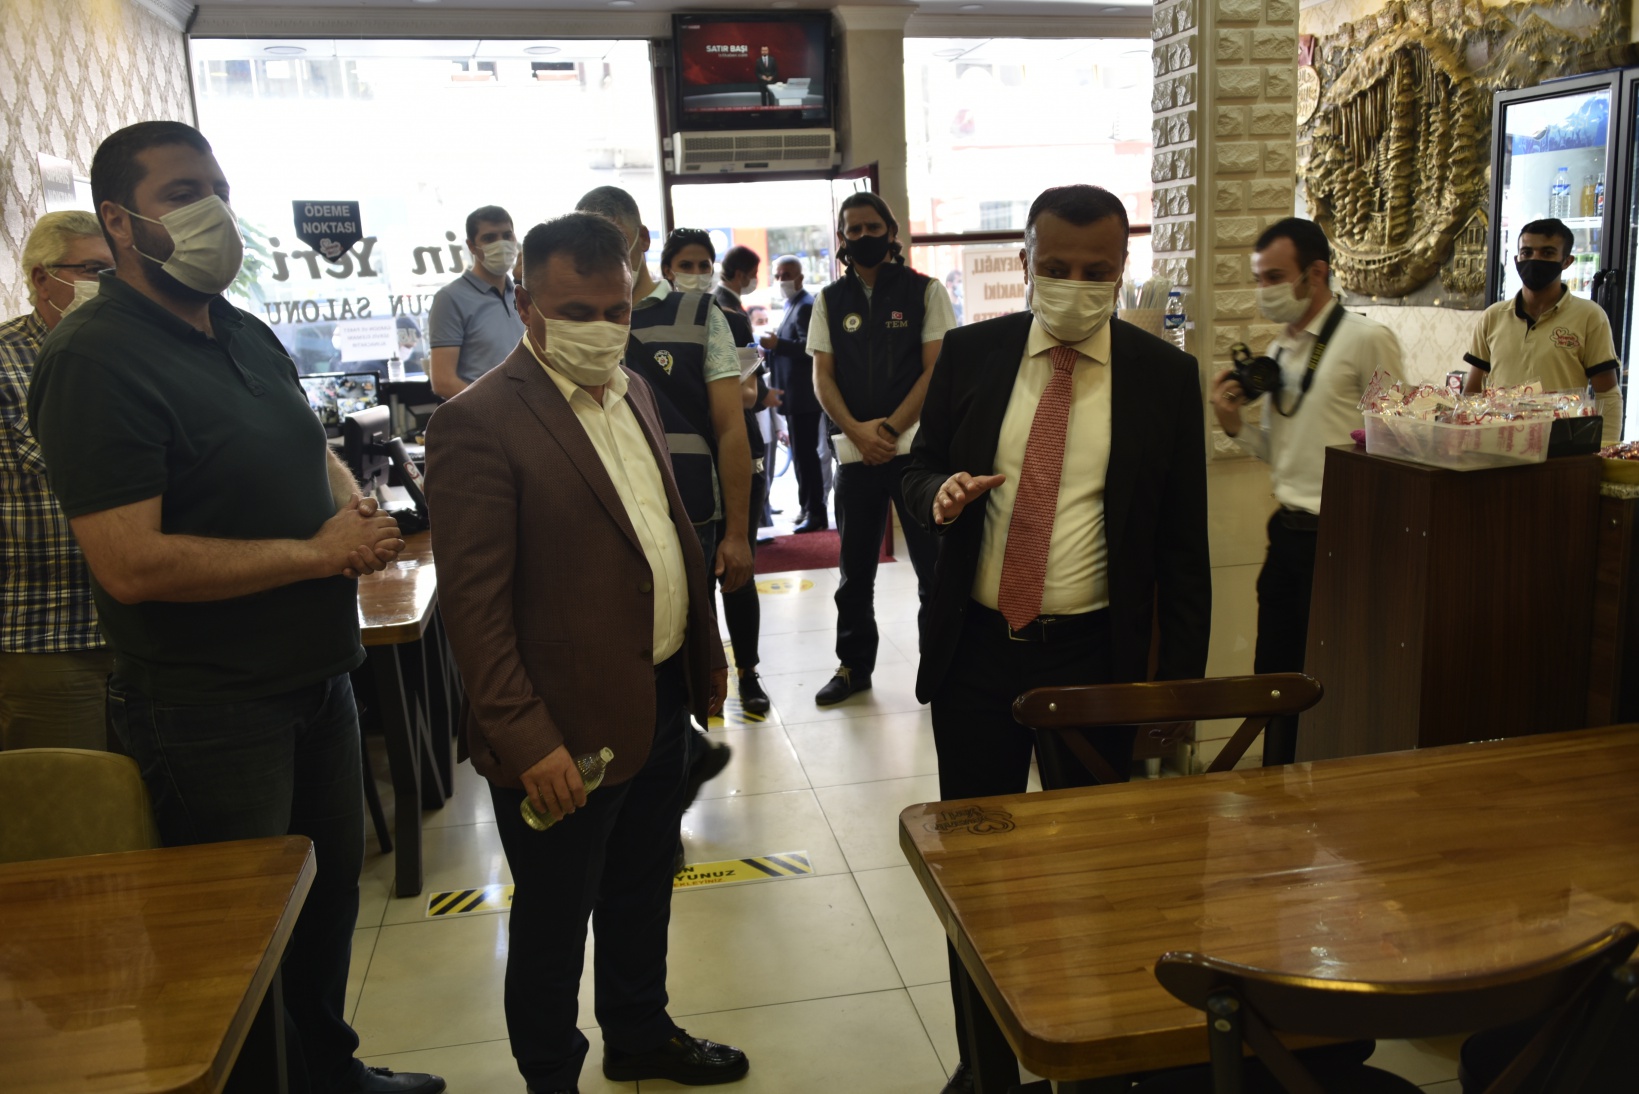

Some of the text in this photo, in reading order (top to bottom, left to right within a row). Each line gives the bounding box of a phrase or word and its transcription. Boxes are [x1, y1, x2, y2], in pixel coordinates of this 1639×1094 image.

[706, 45, 748, 53] SATIR BAŞI
[305, 203, 350, 217] ÖDEME
[303, 222, 356, 234] NOKTASI
[885, 320, 908, 329] TEM
[674, 870, 736, 882] YUNUZ
[673, 878, 722, 887] EKLEYİNİZ
